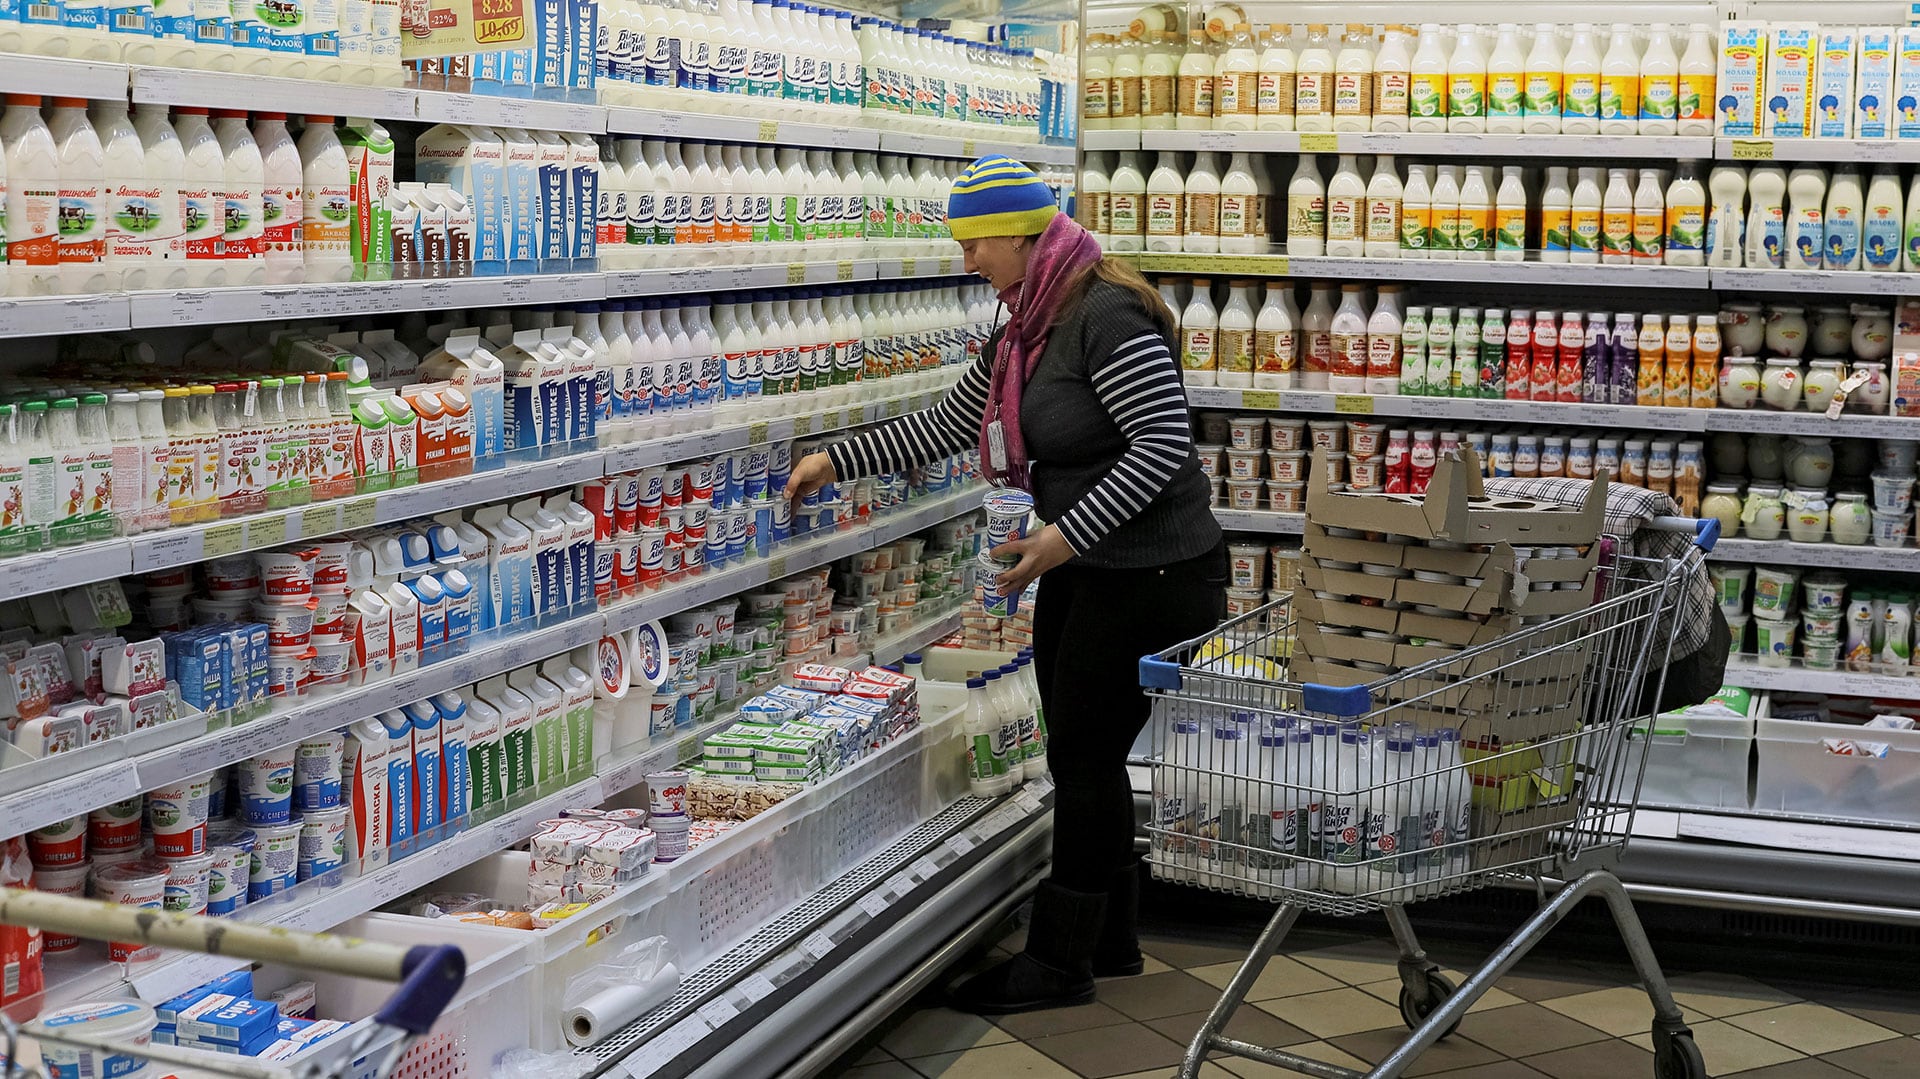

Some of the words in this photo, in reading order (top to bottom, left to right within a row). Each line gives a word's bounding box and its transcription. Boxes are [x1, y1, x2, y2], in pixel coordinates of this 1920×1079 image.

[432, 14, 453, 25] -22%
[544, 1, 557, 87] ВЕЛИКЕ
[578, 6, 591, 88] ВЕЛИКЕ
[1806, 56, 1814, 99] УПАКОВКА
[483, 173, 495, 259] ВЕЛИКЕ
[517, 174, 529, 259] ВЕЛИКЕ
[550, 174, 561, 258] ВЕЛИКЕ
[581, 175, 592, 258] ВЕЛИКЕ
[58, 248, 96, 256] ЖАНКА
[431, 243, 439, 277] КАКАО
[457, 241, 465, 275] КАКАО
[485, 394, 494, 458] ВЕЛИКЕ
[503, 387, 516, 449] ВЕЛИКЕ
[549, 386, 558, 445] ВЕЛИКЕ
[579, 383, 588, 441] ВЕЛИКЕ
[511, 564, 520, 624] ВЕЛИКЕ
[548, 555, 557, 614] ВЕЛИКЕ
[580, 546, 588, 605] ВЕЛИКЕ
[398, 772, 407, 836] ЗАКВАСКА
[425, 762, 434, 825] ЗАКВАСКА
[453, 751, 461, 814] ЗАКВАСКА
[372, 782, 382, 847] ЗАКВАСКА
[45, 852, 76, 861] СМЕТАНА
[216, 1000, 253, 1019] СИР
[278, 1019, 296, 1033] ИР
[111, 1060, 131, 1074] СИР
